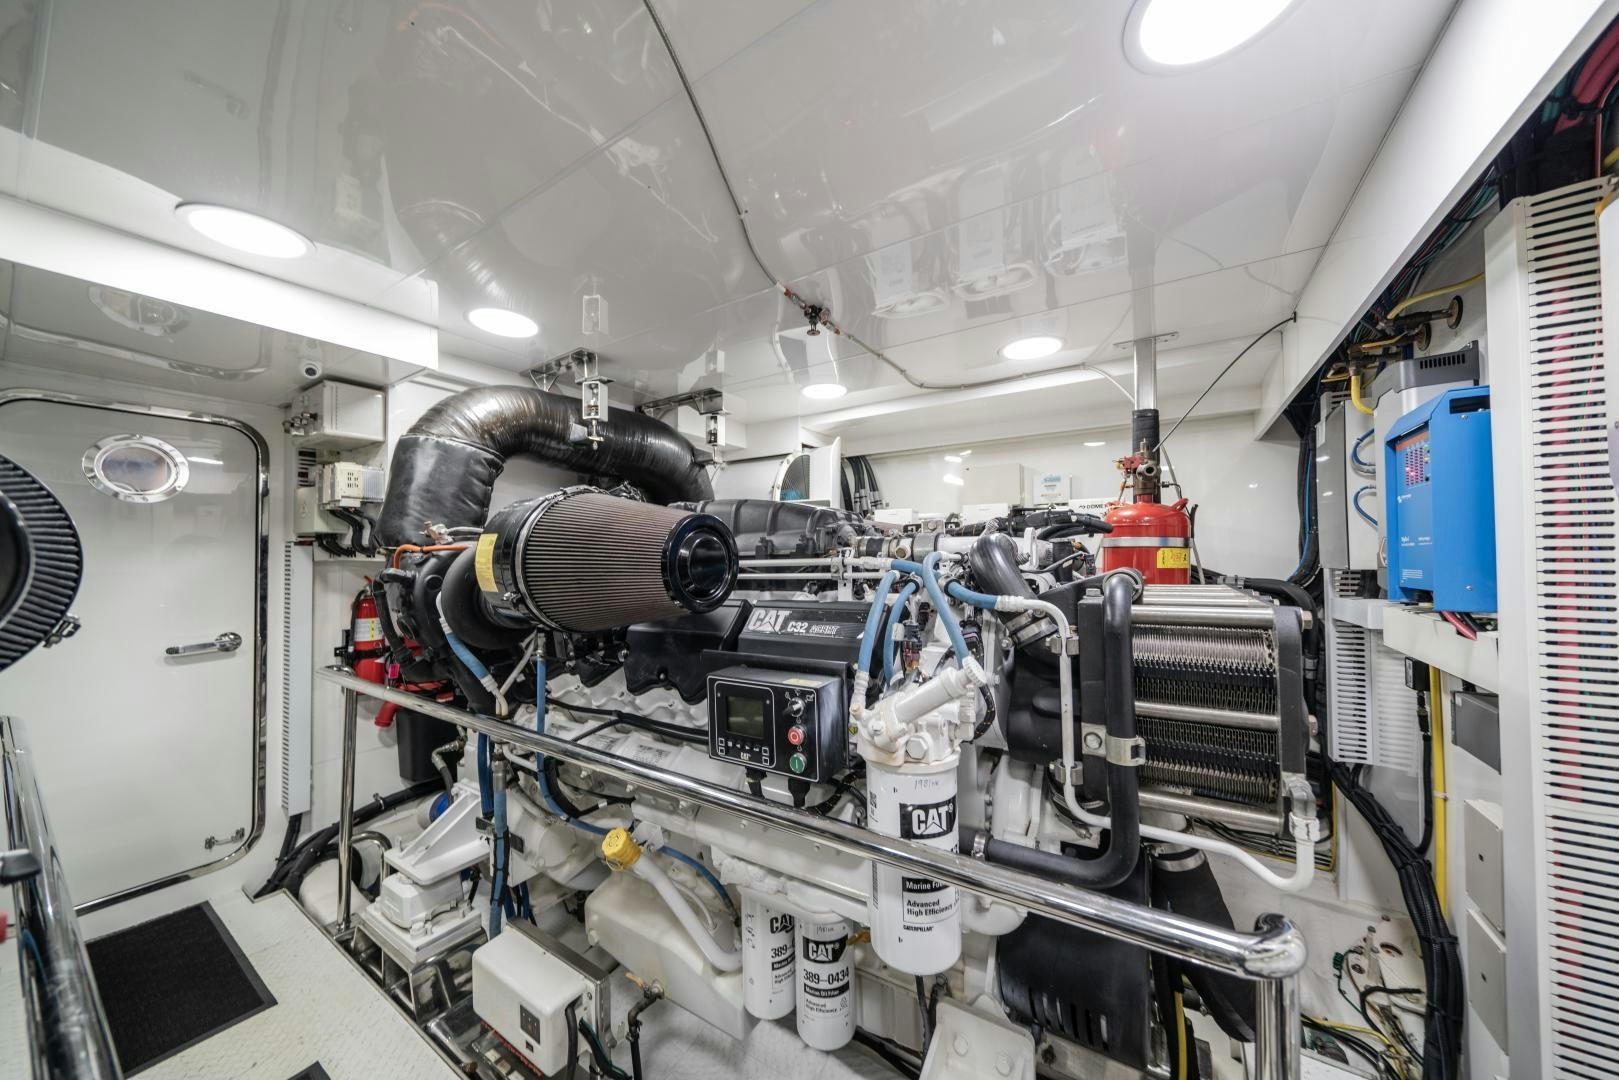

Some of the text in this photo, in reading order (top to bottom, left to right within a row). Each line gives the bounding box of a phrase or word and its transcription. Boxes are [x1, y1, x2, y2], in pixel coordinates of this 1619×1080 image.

[747, 608, 792, 634] CAT
[787, 621, 809, 633] C32
[740, 752, 750, 760] CAT
[912, 805, 950, 835] CAT
[906, 881, 931, 890] Marine
[906, 903, 953, 917] High Efficiency
[907, 898, 940, 908] Advanced
[808, 941, 834, 960] CAT
[804, 966, 849, 985] 389-0434
